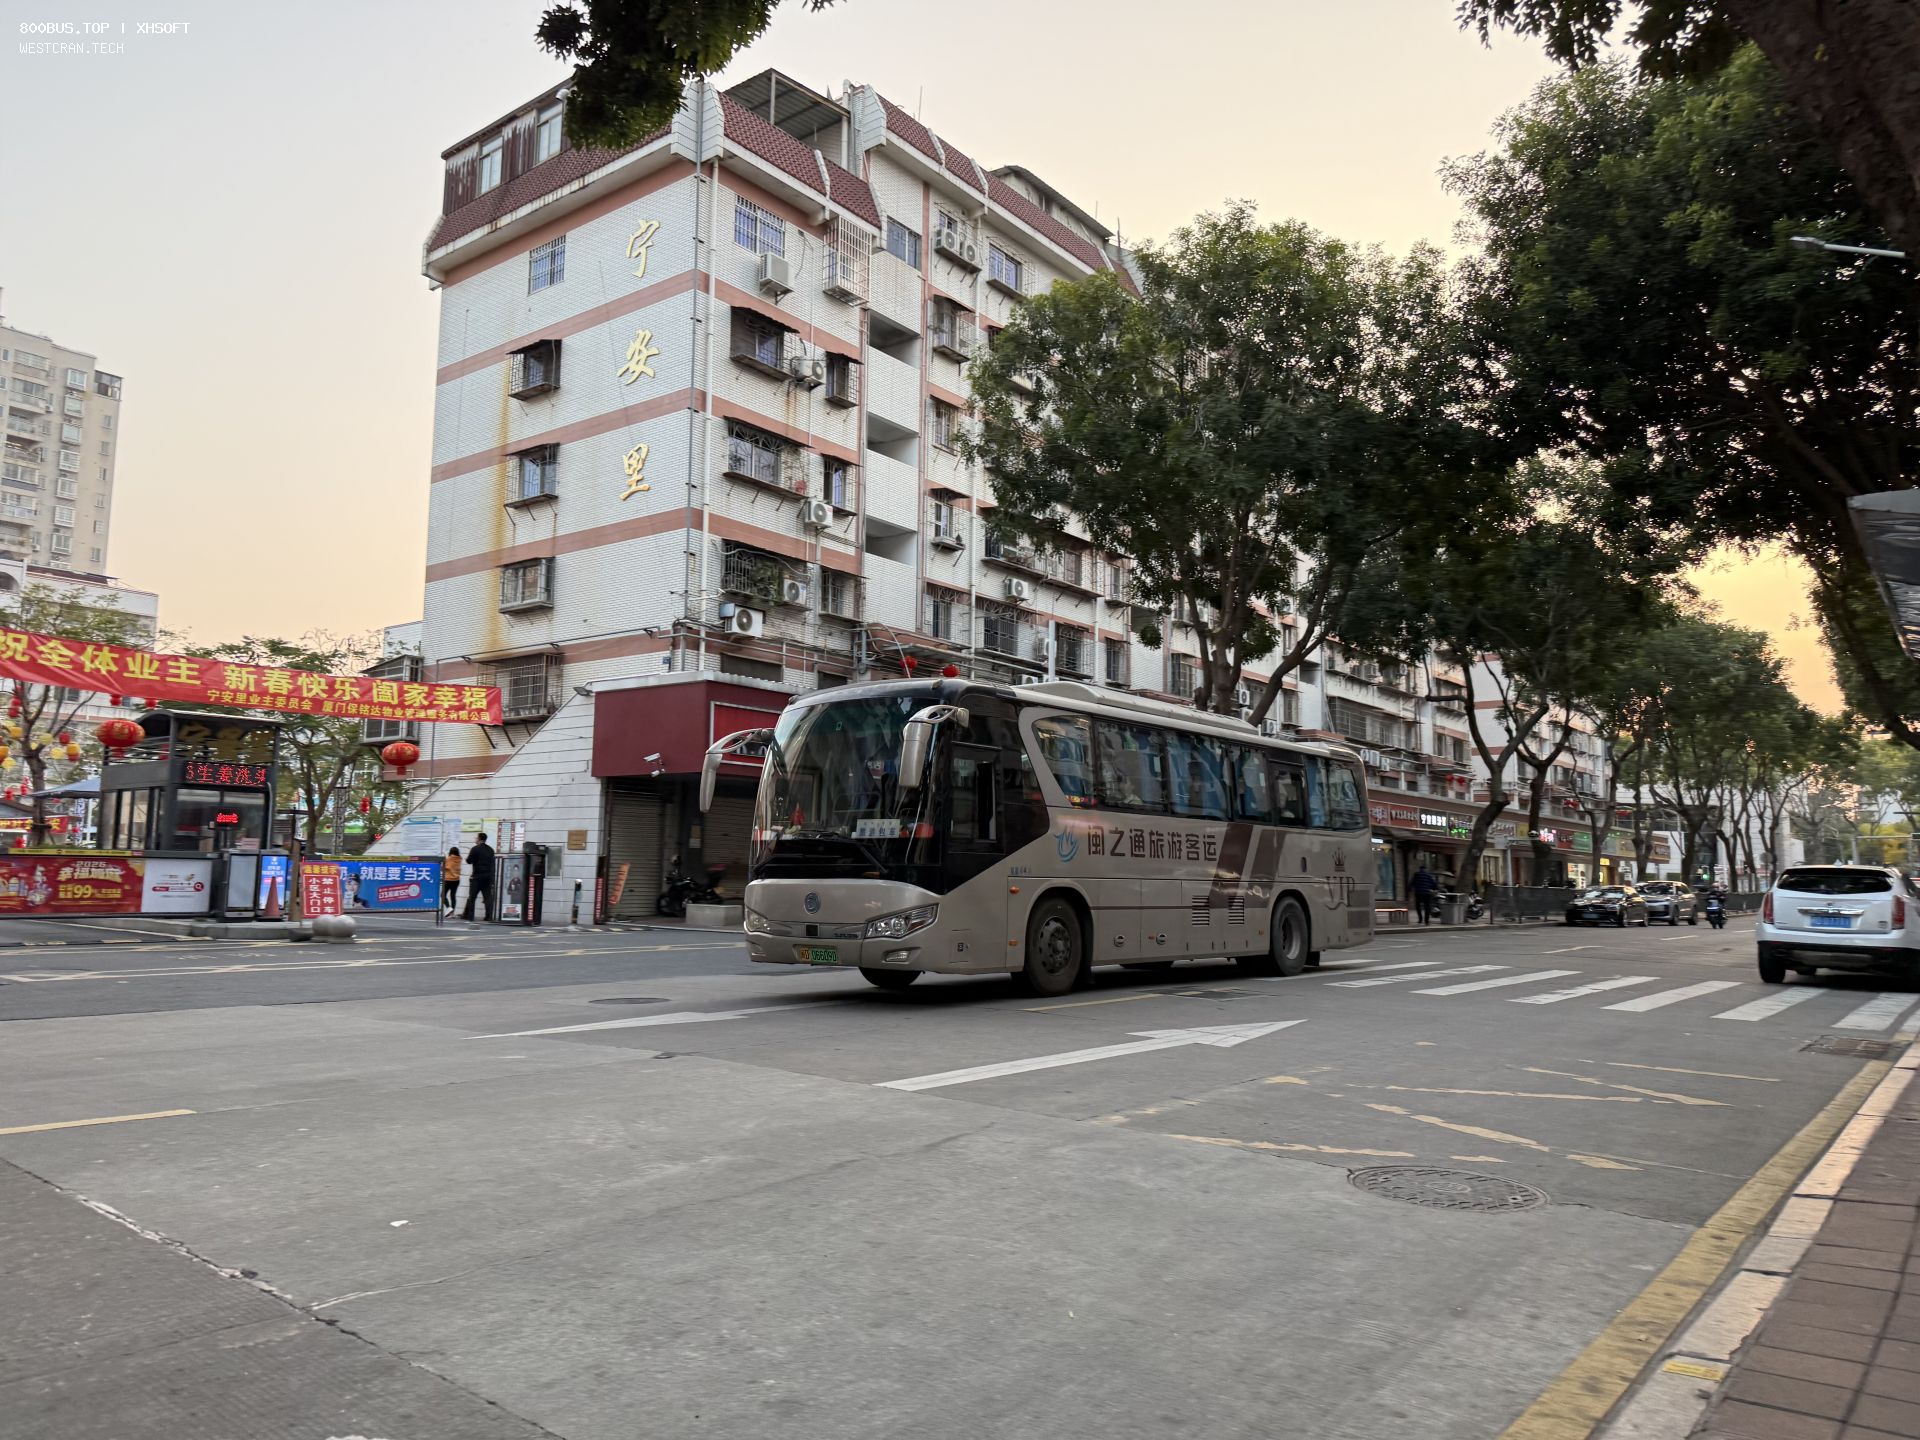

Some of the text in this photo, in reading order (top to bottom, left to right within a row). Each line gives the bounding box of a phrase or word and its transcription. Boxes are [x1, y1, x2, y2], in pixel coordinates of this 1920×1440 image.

[617, 219, 661, 502] 宁安里
[0, 629, 488, 711] 祝全体业主 新春快乐 阖家幸福
[206, 689, 313, 711] 宁安里业主委员会
[1087, 824, 1218, 862] 闽之通旅游客运
[307, 877, 321, 913] 小区大门口
[321, 877, 336, 914] 禁止停车
[1325, 876, 1355, 908] VIP
